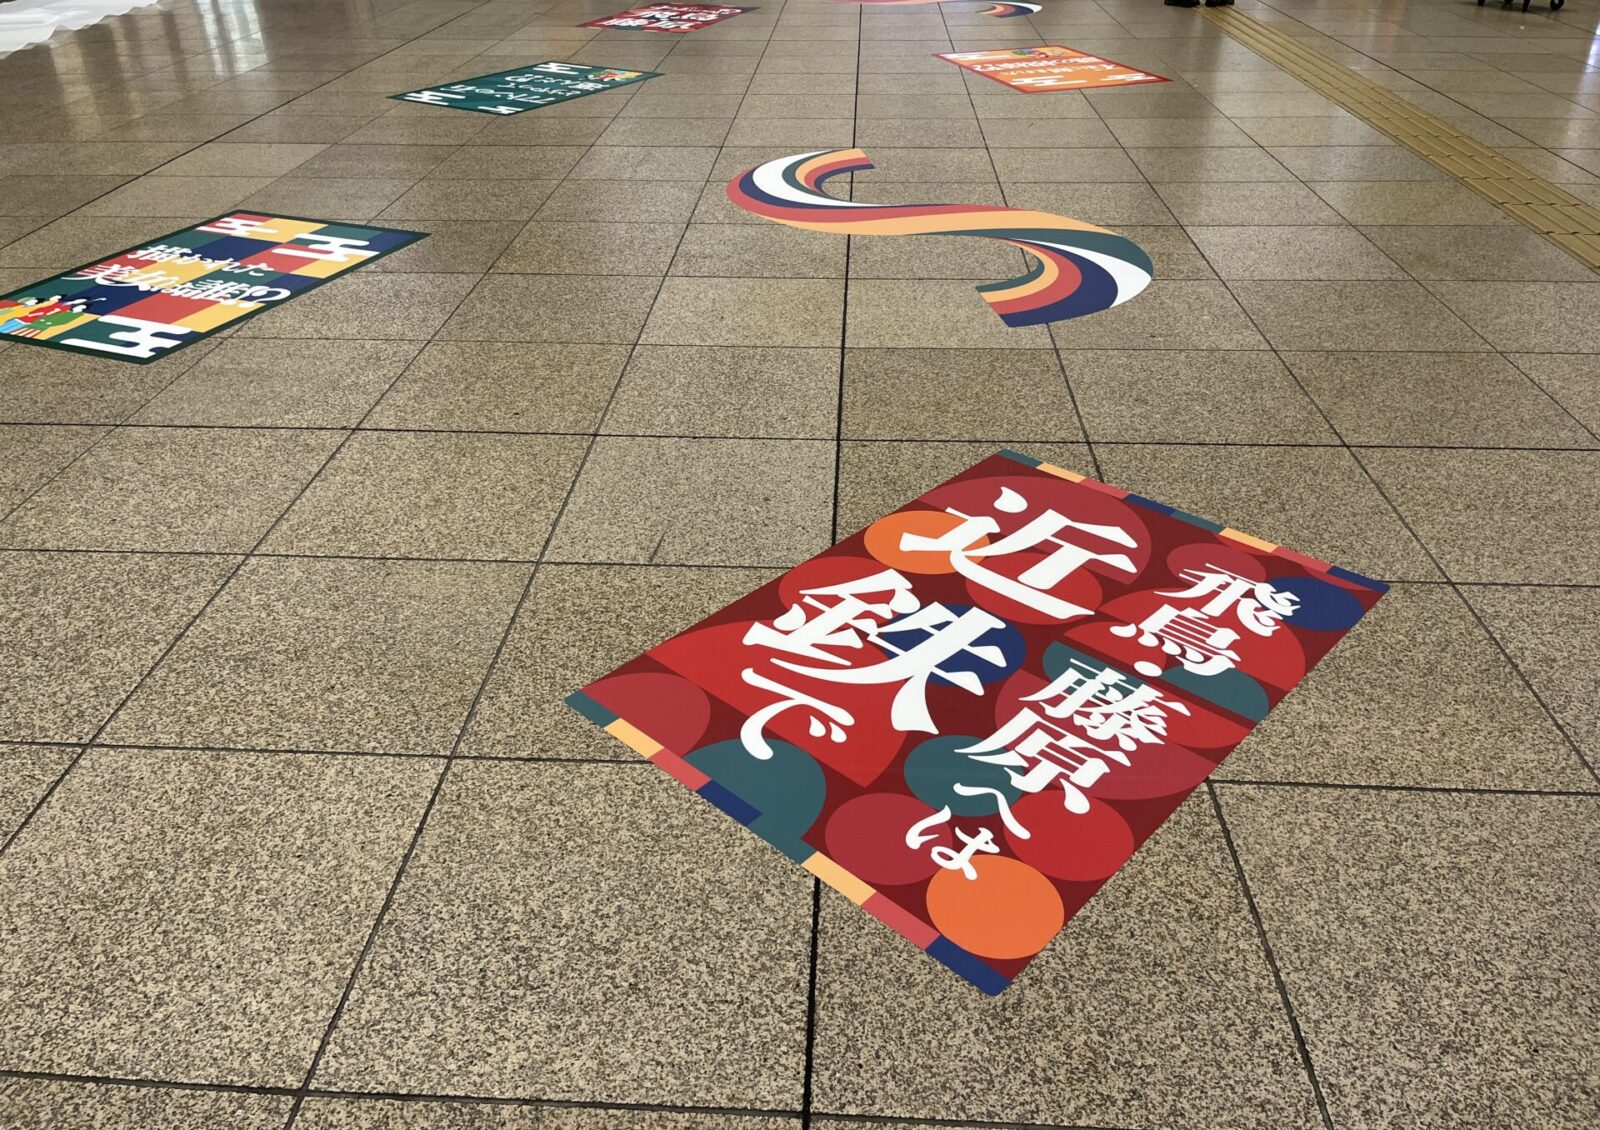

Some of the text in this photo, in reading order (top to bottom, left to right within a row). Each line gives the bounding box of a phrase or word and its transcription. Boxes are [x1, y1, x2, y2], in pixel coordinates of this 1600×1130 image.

[62, 263, 292, 309] 美女は誰!?
[126, 243, 275, 277] 描かれた
[740, 486, 1139, 760] 近鉄で
[905, 562, 1302, 880] 飛鳥・藤原へは
